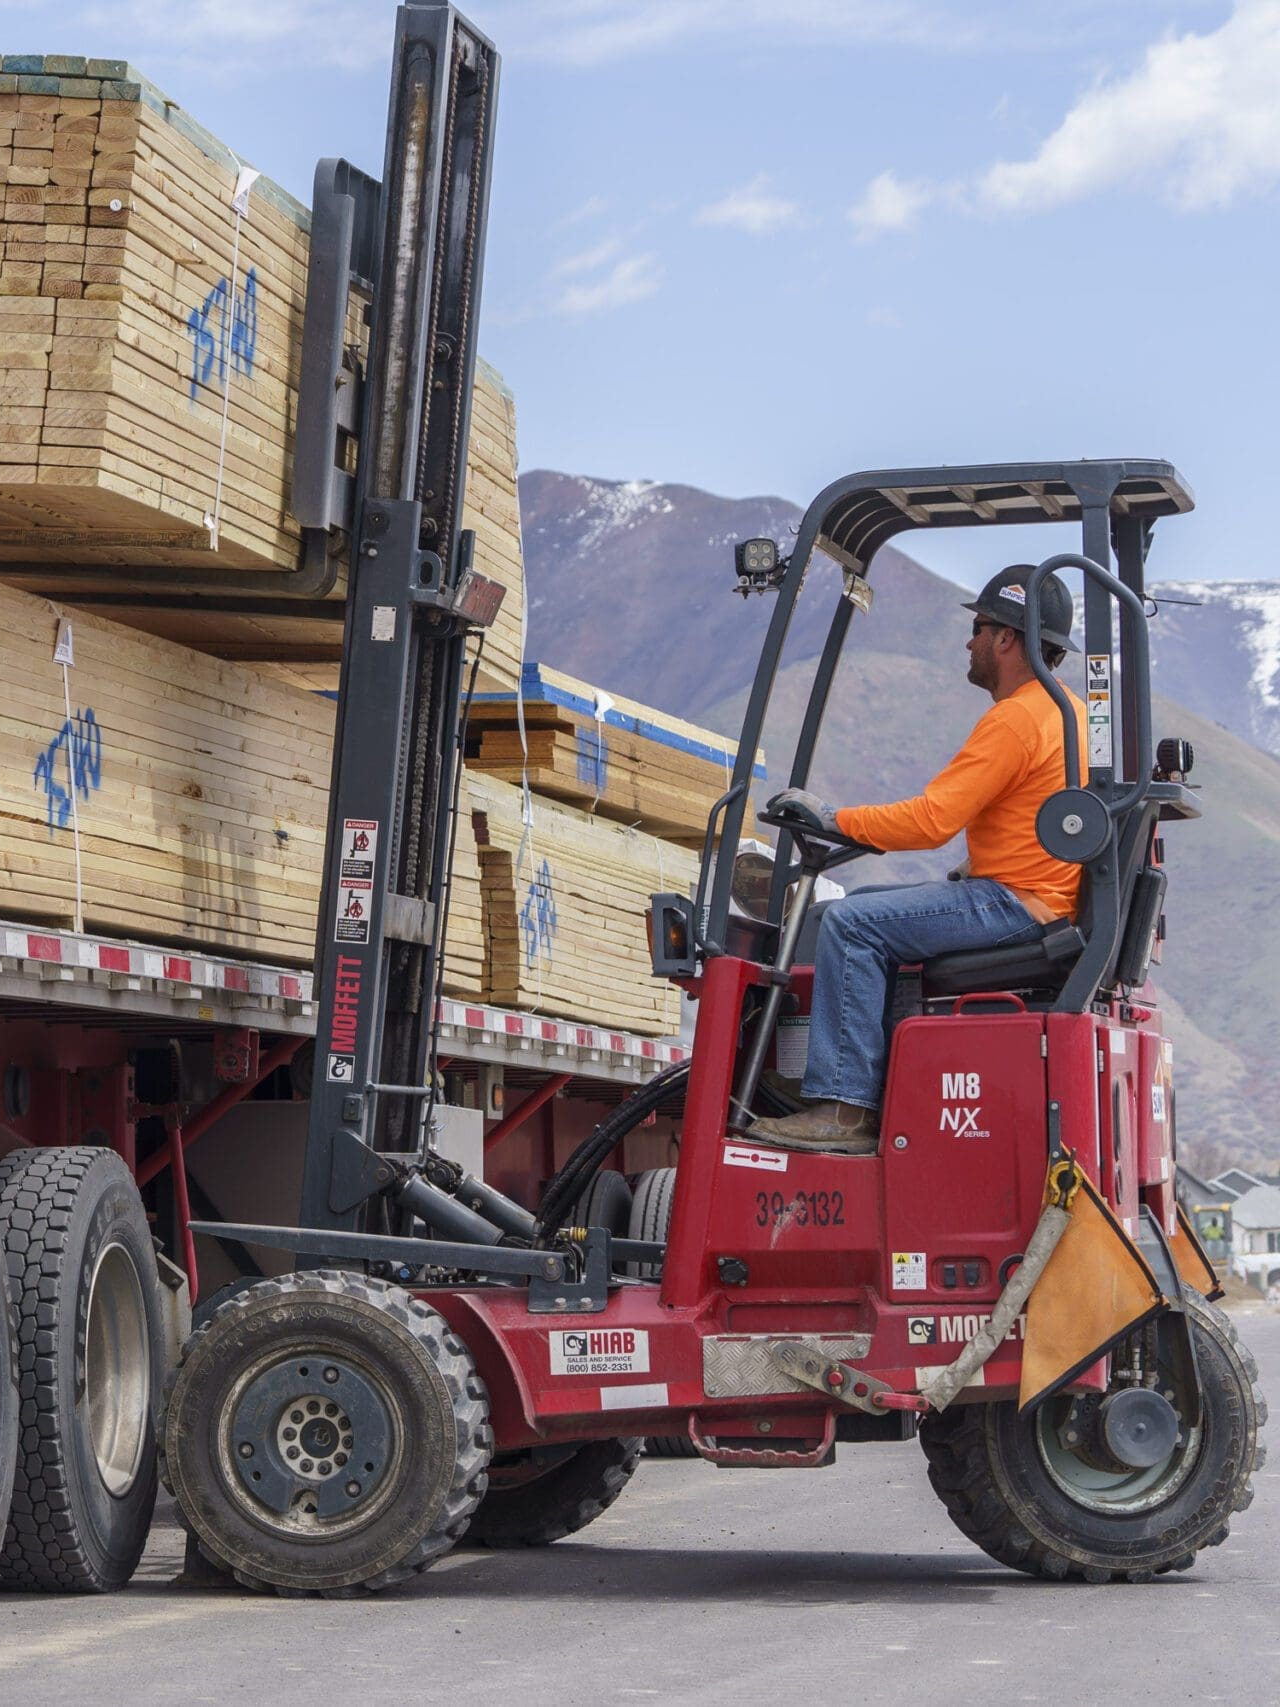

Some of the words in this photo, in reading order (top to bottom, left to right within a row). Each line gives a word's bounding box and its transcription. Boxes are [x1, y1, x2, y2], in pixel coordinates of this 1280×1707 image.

[330, 954, 362, 1052] MOFFETT
[942, 1072, 981, 1099] M8
[939, 1107, 981, 1137] NX
[756, 1190, 845, 1227] 39-3132
[590, 1331, 635, 1355] HIAB
[566, 1364, 589, 1373] (800)
[591, 1363, 633, 1372] 852-2331
